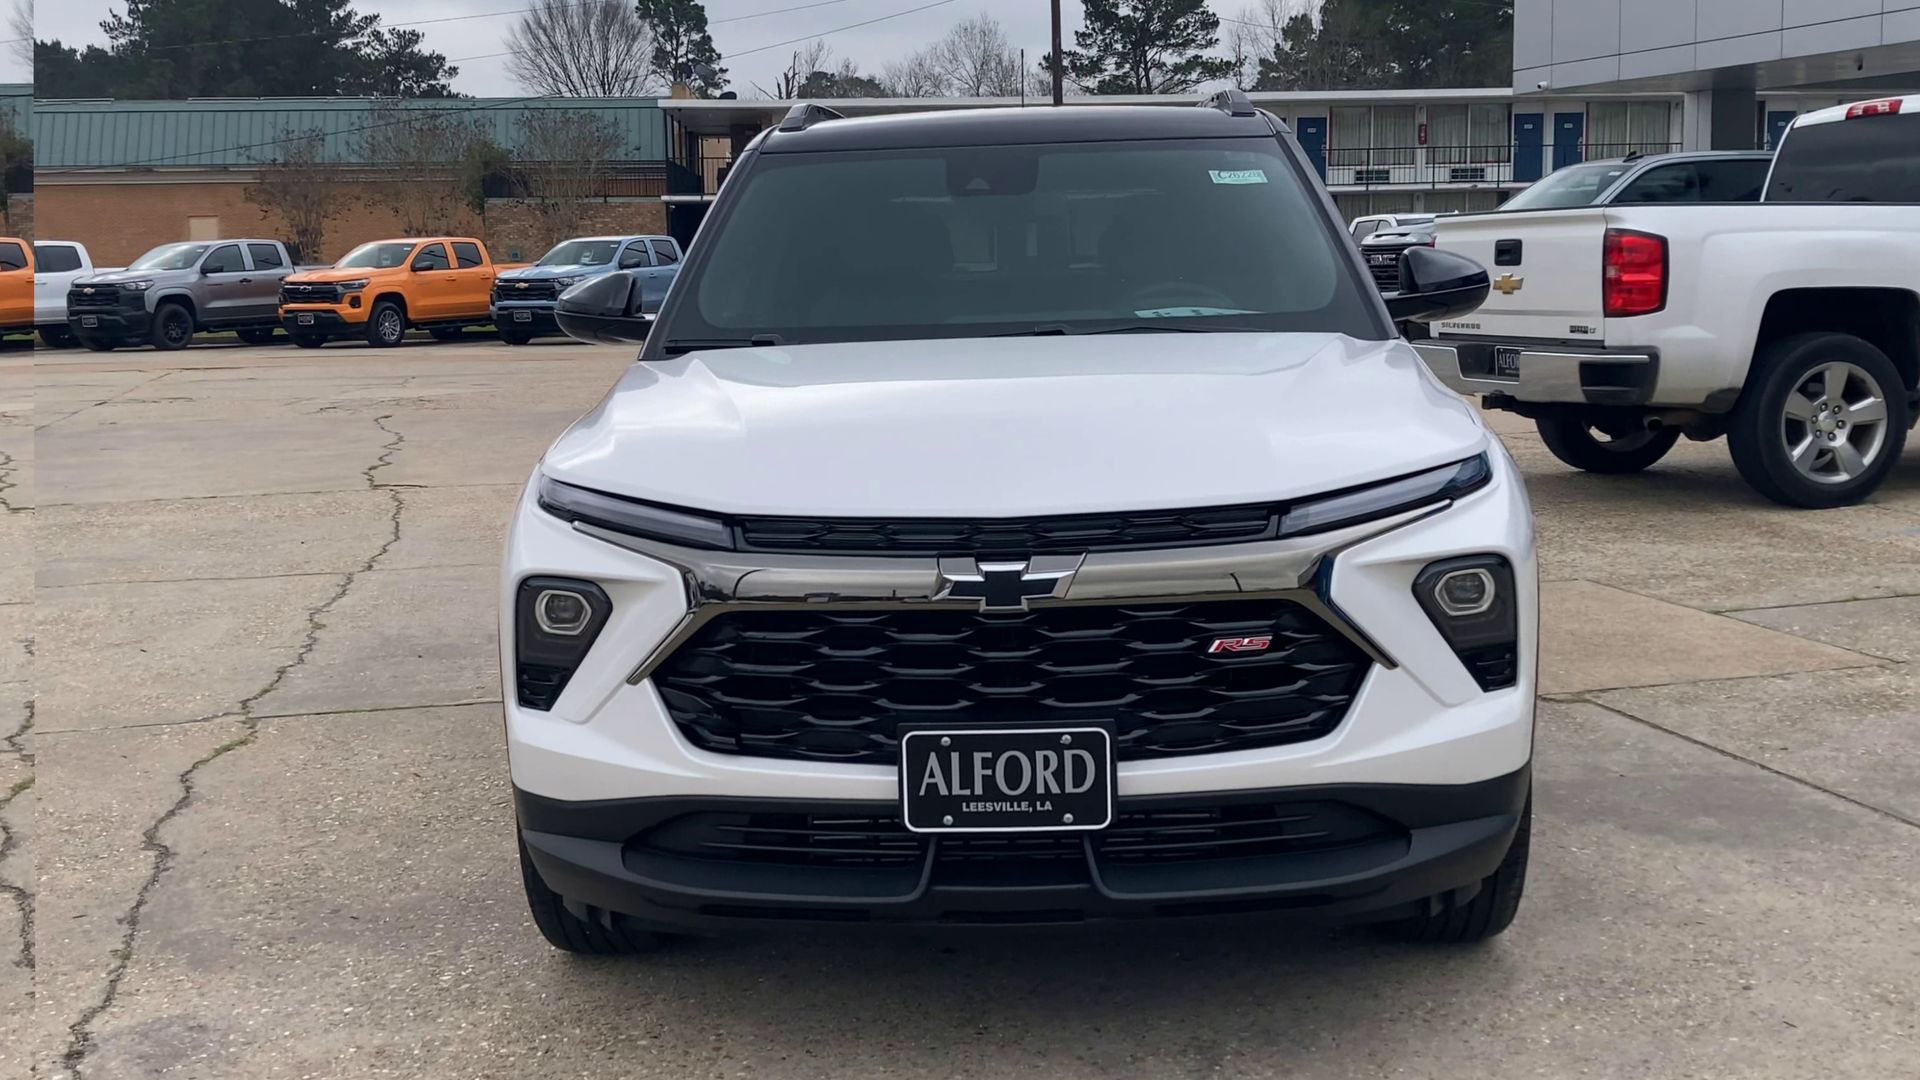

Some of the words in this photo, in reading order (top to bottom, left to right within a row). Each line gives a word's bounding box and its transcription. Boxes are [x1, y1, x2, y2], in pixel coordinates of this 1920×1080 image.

[1208, 635, 1273, 653] RS
[918, 749, 1096, 797] ALFORD
[962, 802, 1033, 813] LEESVILLE,
[1036, 801, 1053, 811] LA
